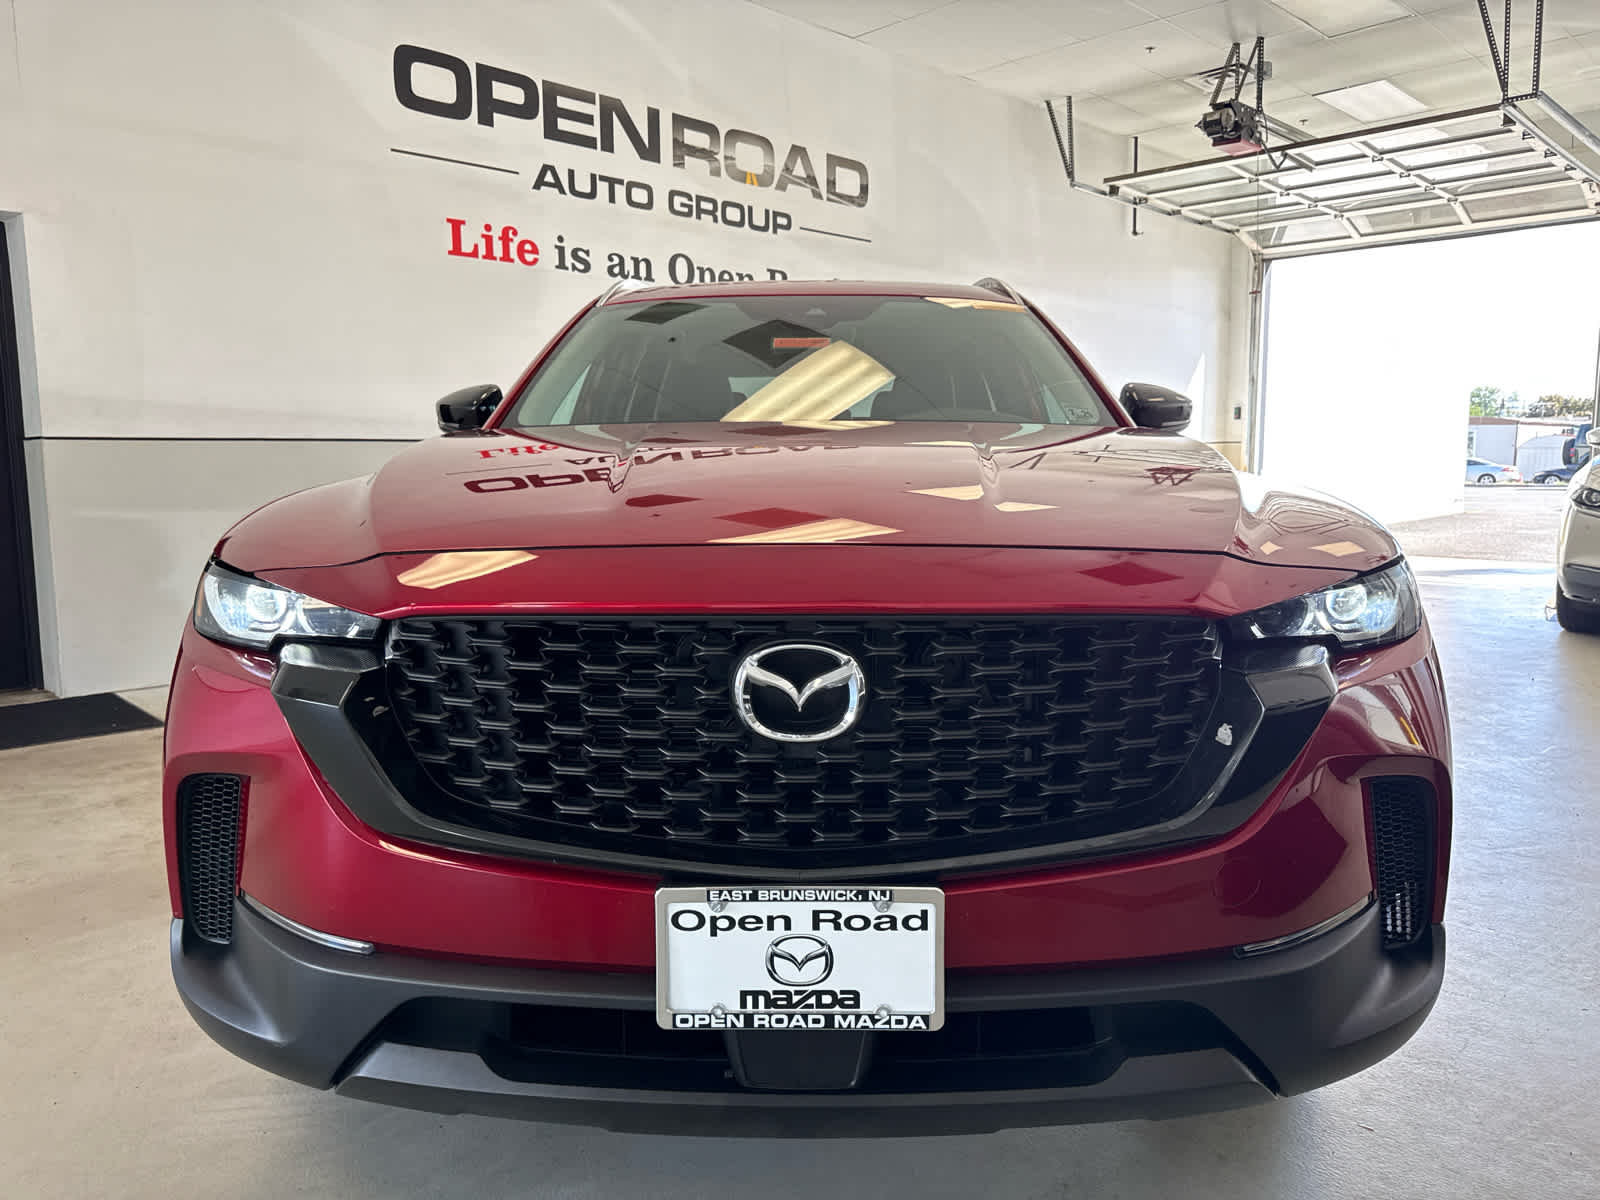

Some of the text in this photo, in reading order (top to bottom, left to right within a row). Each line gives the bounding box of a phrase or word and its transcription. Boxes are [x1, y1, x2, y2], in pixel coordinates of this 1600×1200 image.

[532, 163, 792, 235] AUTO GROUP
[446, 217, 540, 267] Life
[554, 235, 592, 274] is
[607, 251, 655, 283] an
[708, 889, 891, 903] EAST BRUNSWICK, NJ
[670, 909, 929, 937] Open Road
[674, 1013, 928, 1030] OPEN ROAD MAZDA
